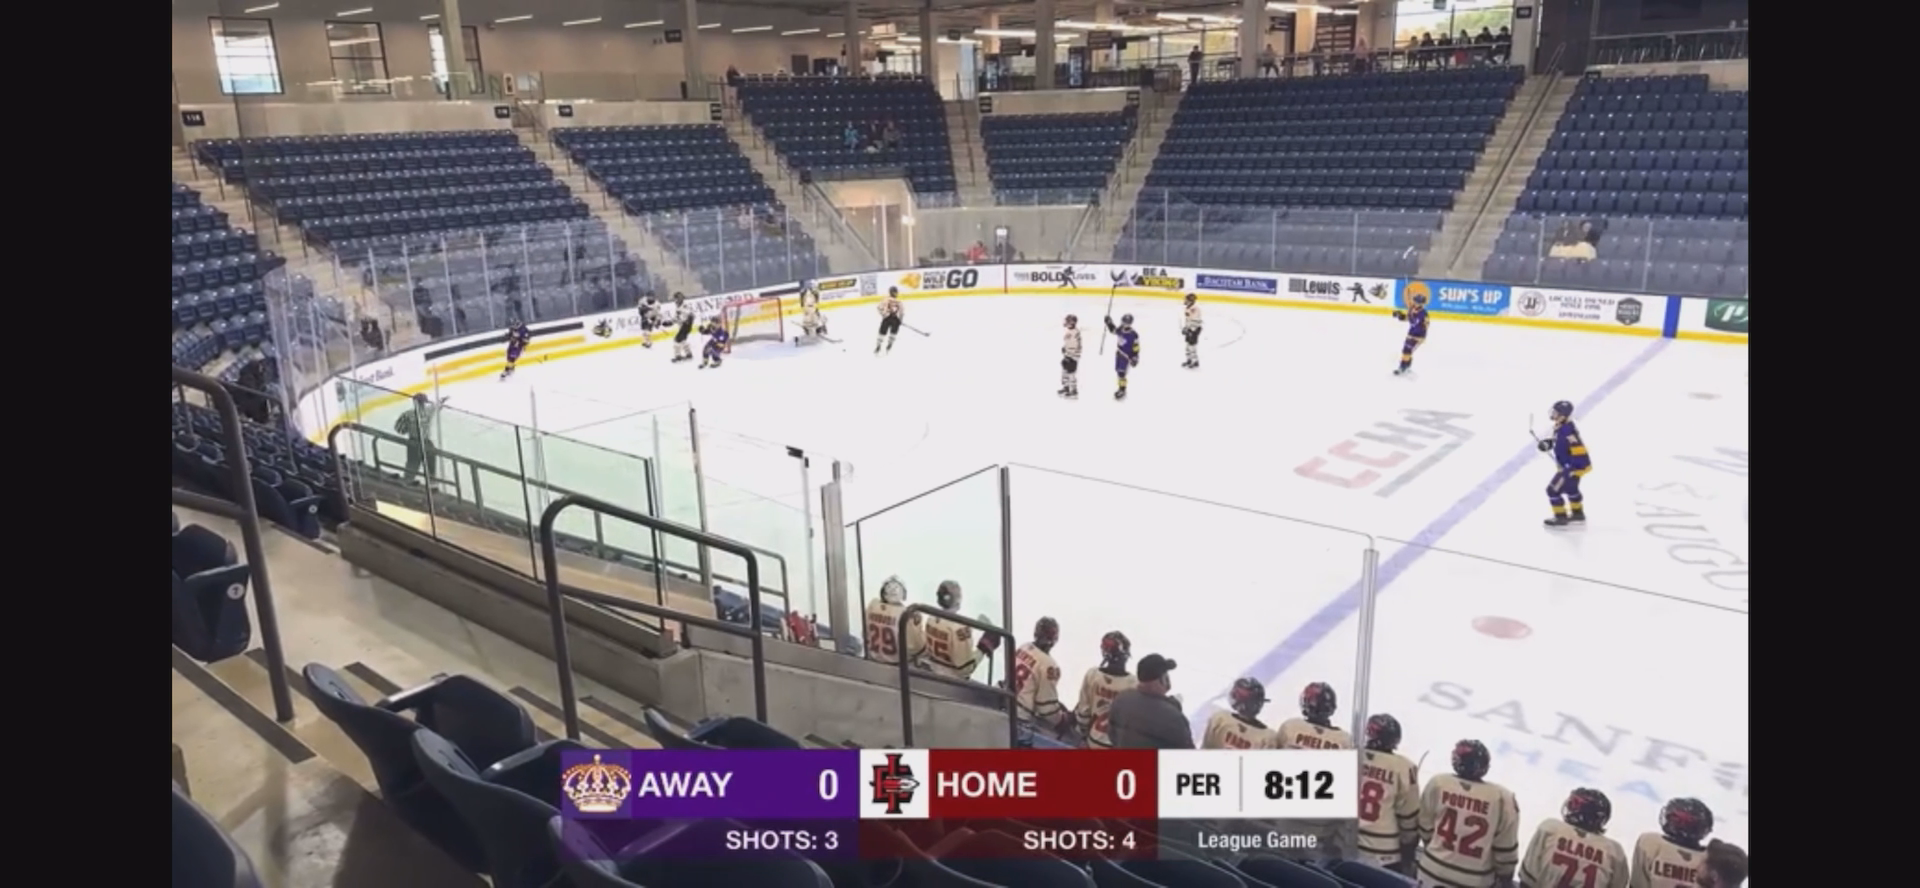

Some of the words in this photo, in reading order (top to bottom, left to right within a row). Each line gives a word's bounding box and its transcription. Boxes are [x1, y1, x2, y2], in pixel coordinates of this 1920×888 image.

[946, 268, 979, 289] GO
[1031, 270, 1064, 282] BOLD
[1143, 267, 1156, 276] BE
[1159, 268, 1168, 277] A
[1245, 279, 1269, 290] BANK
[1439, 286, 1479, 302] SUN'S
[1483, 290, 1502, 304] UP
[1293, 408, 1476, 489] CCHA
[869, 623, 897, 655] 29
[1360, 781, 1385, 822] 8
[1441, 790, 1490, 815] POUTRE
[1436, 807, 1489, 859] 42
[1552, 852, 1600, 888] 71
